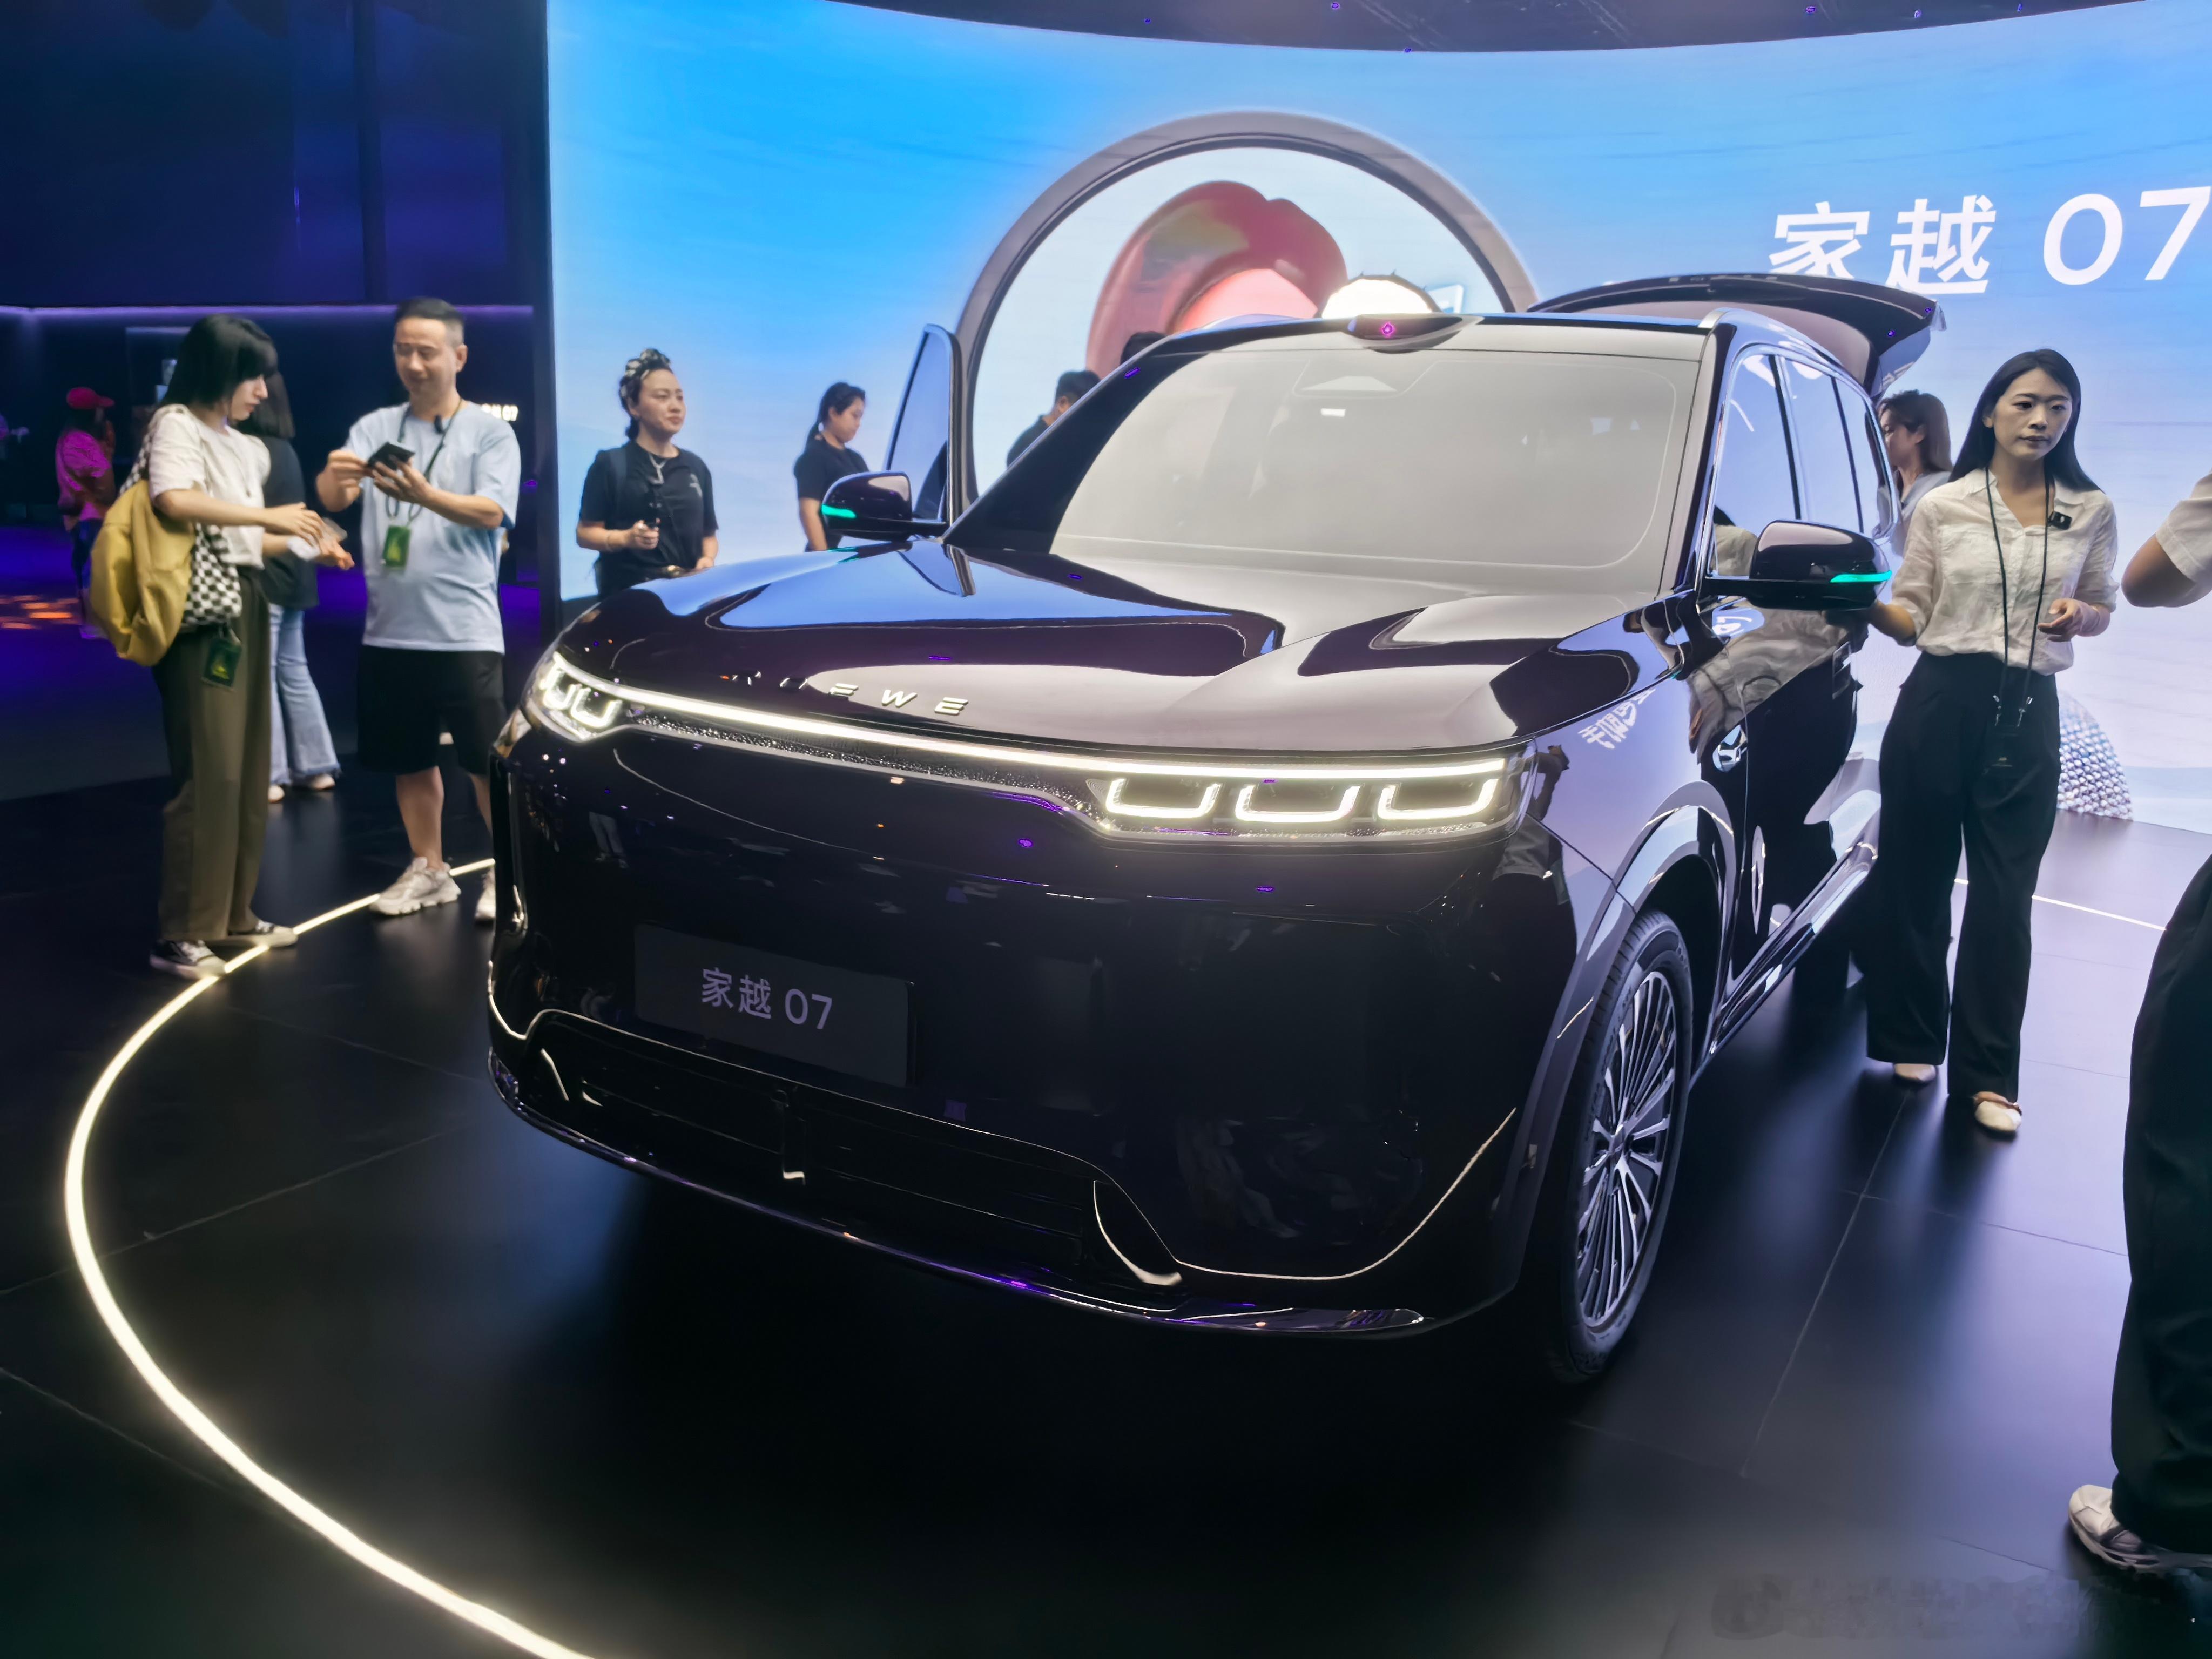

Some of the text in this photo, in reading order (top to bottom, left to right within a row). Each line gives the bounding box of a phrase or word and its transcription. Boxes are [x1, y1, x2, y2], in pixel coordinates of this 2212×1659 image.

[1768, 186, 2211, 294] 家越 07
[702, 967, 833, 1030] 家越 07
